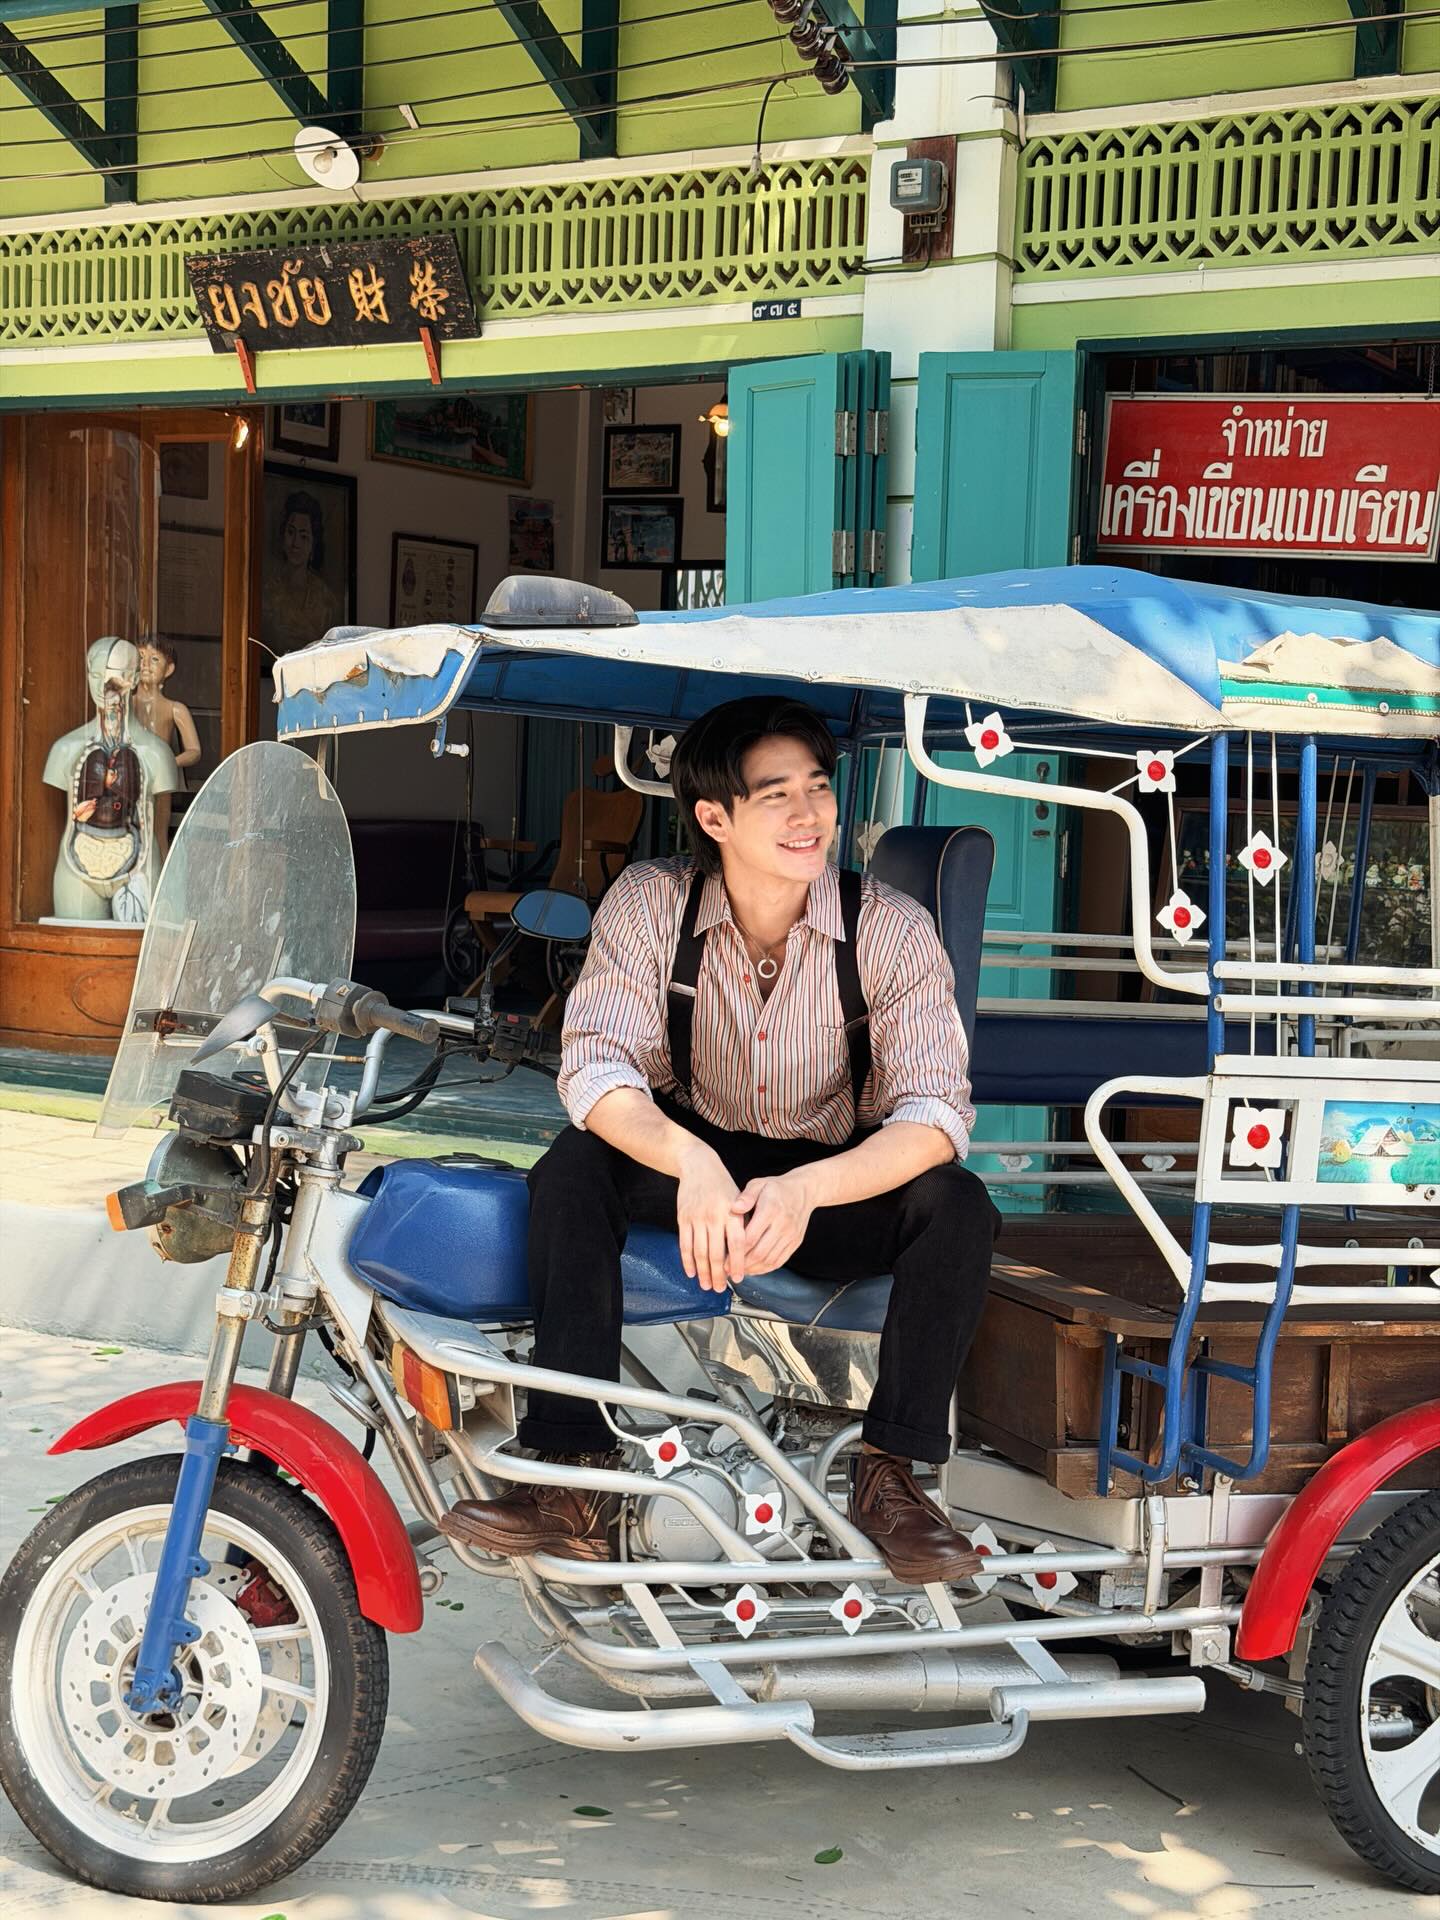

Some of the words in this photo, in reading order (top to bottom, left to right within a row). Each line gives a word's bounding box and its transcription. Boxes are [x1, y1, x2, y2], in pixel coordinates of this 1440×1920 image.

[1221, 405, 1328, 457] จำหน่าย
[1101, 449, 1434, 546] เครื่องเขียนแบบเรียน
